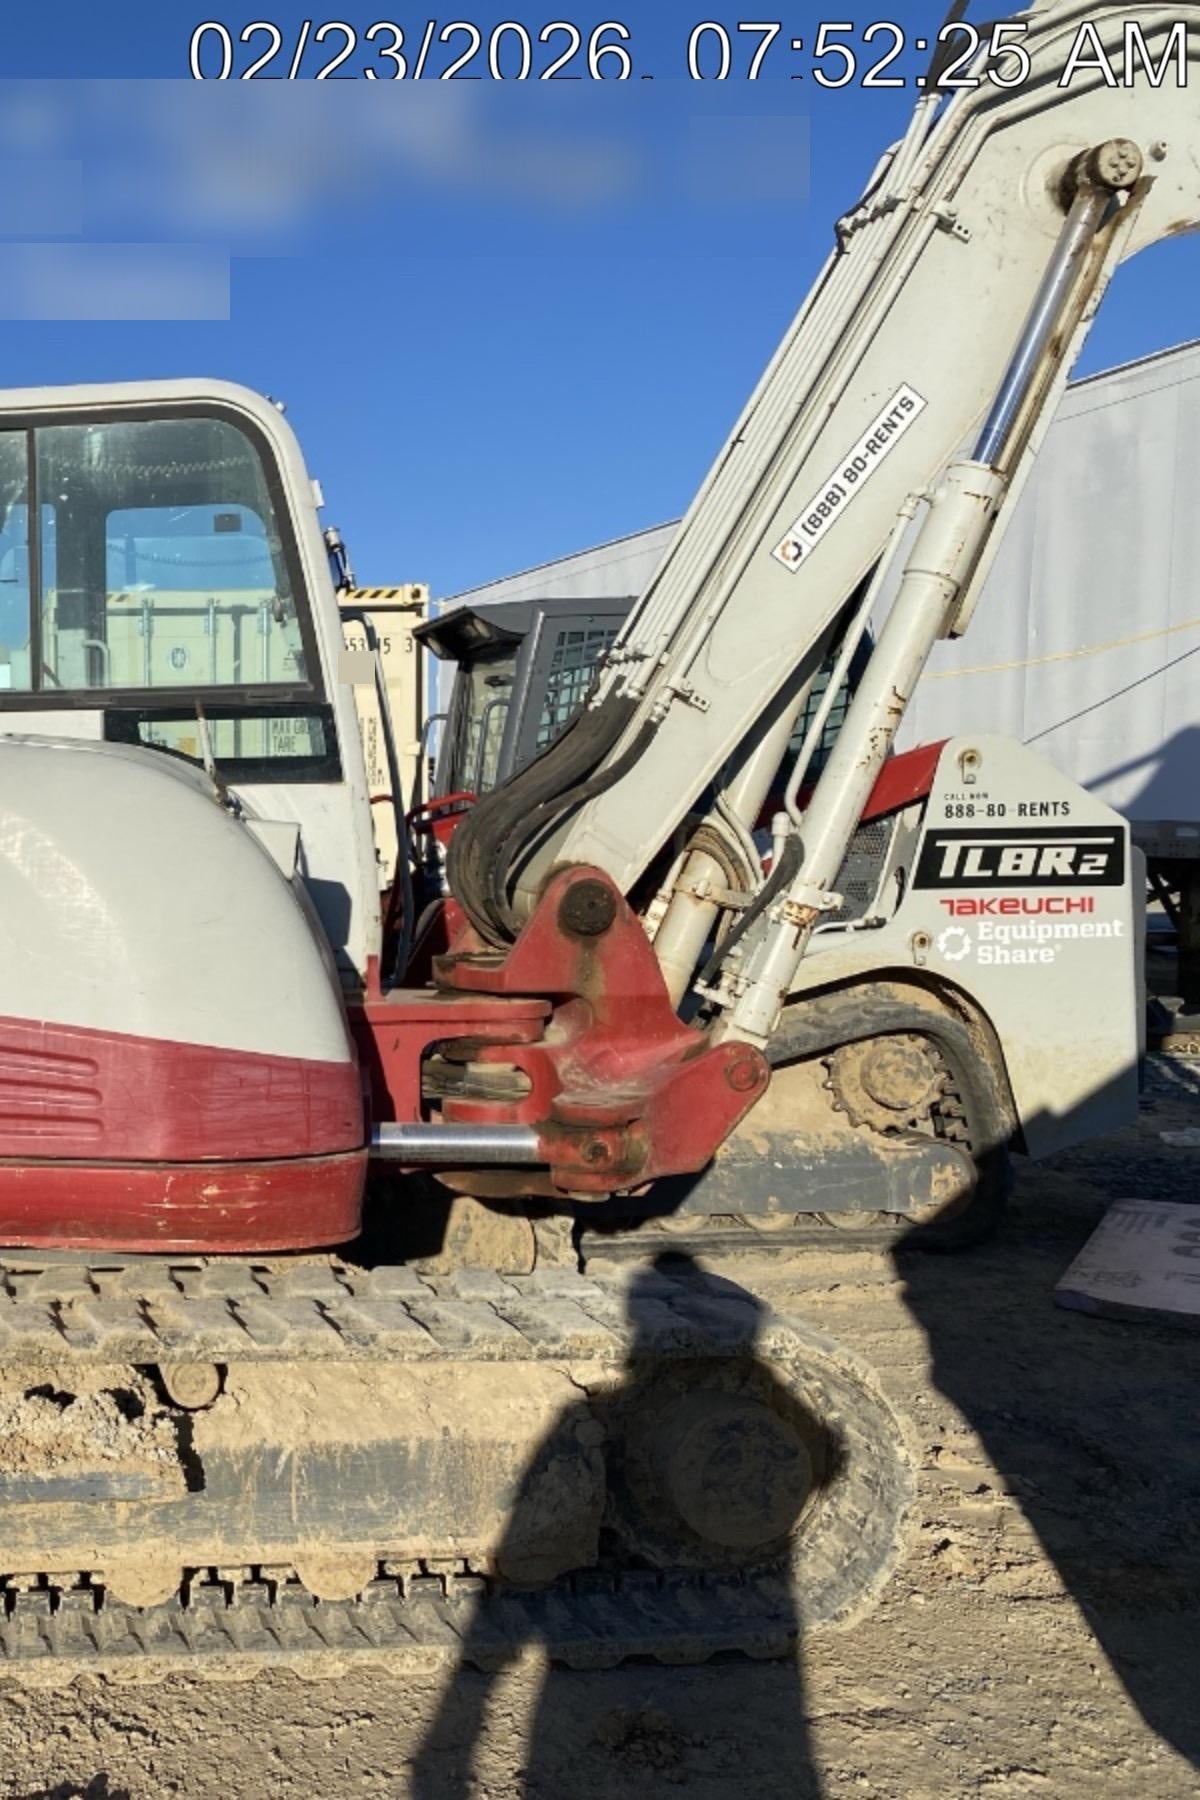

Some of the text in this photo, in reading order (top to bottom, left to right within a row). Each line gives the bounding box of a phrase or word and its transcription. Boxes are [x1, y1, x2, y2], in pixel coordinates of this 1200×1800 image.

[801, 396, 915, 536] (888) 80-RENTS
[943, 793, 967, 801] CALL
[940, 896, 1094, 916] TAKEUCHI
[976, 919, 1124, 943] Equipment
